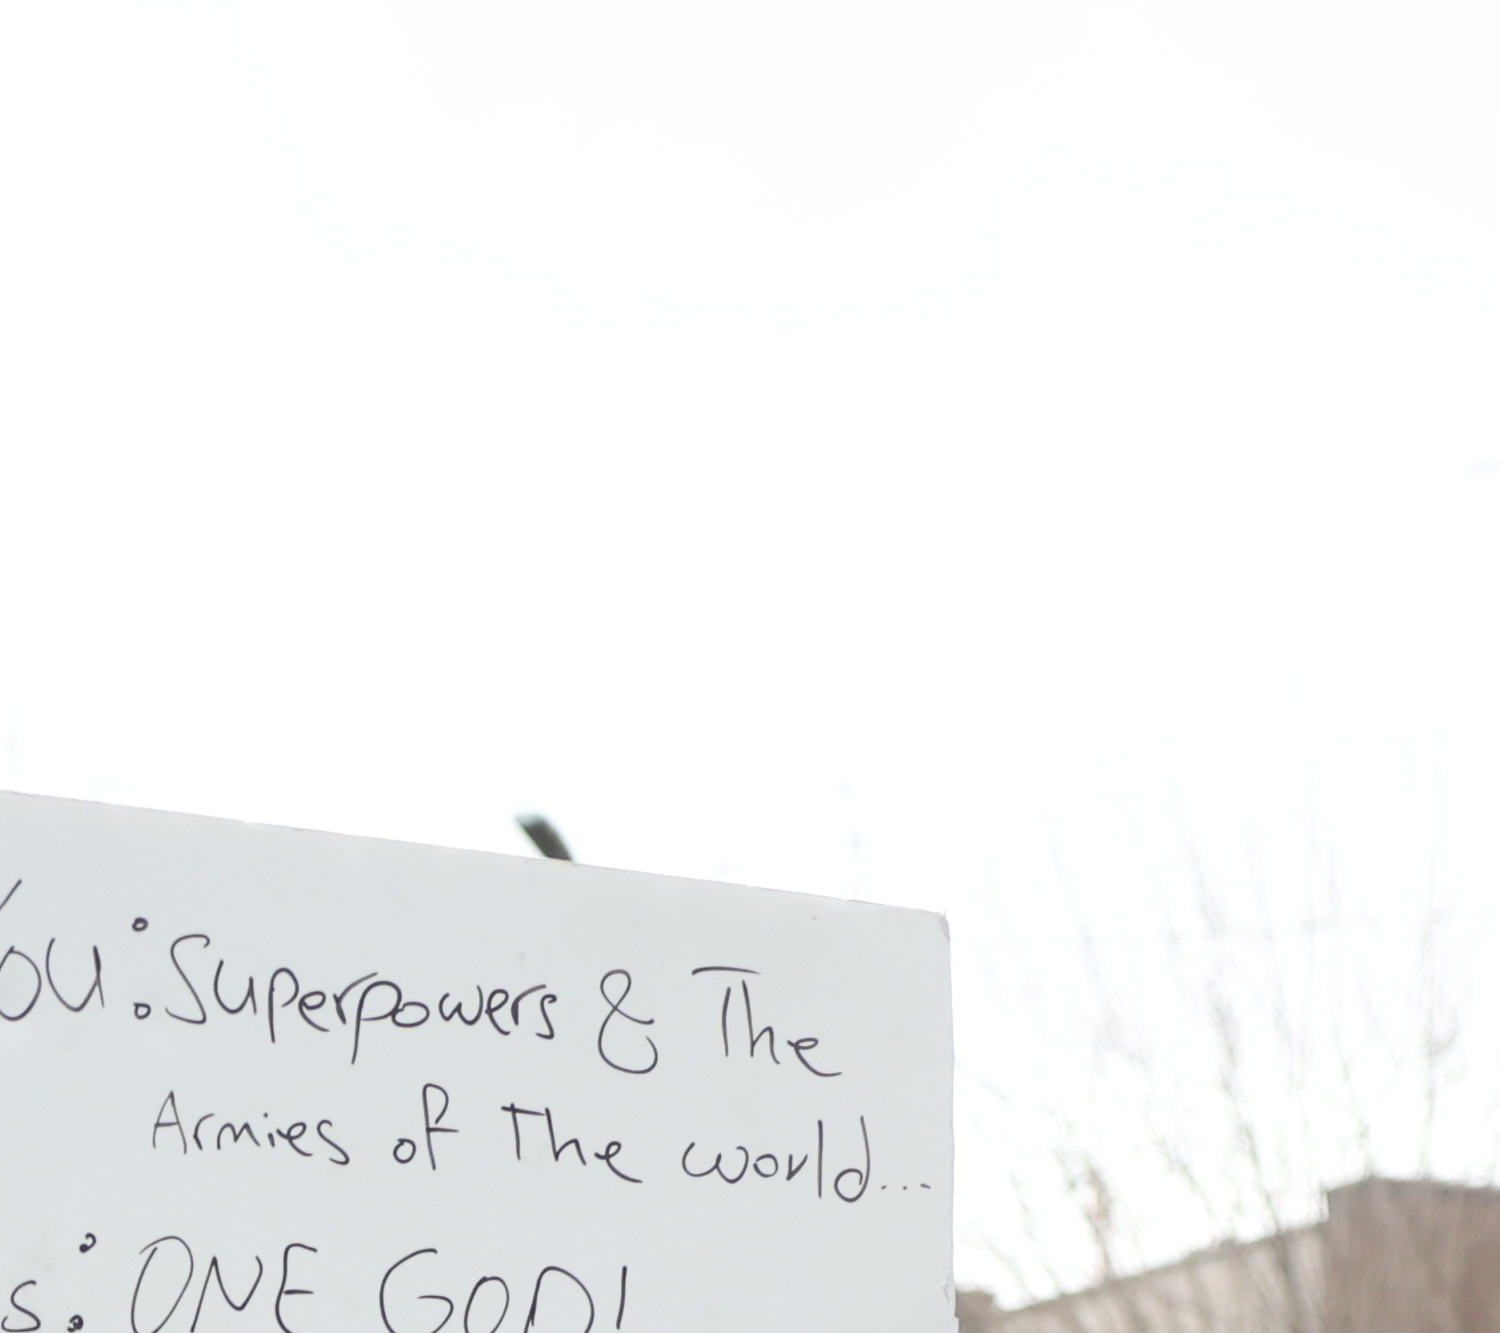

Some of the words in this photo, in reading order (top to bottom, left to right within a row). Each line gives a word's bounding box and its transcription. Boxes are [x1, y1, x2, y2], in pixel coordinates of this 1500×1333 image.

[165, 934, 558, 1064] Superpowers
[597, 968, 659, 1075] &
[691, 966, 842, 1077] The
[153, 1091, 350, 1166] Armies
[393, 1083, 459, 1170] of
